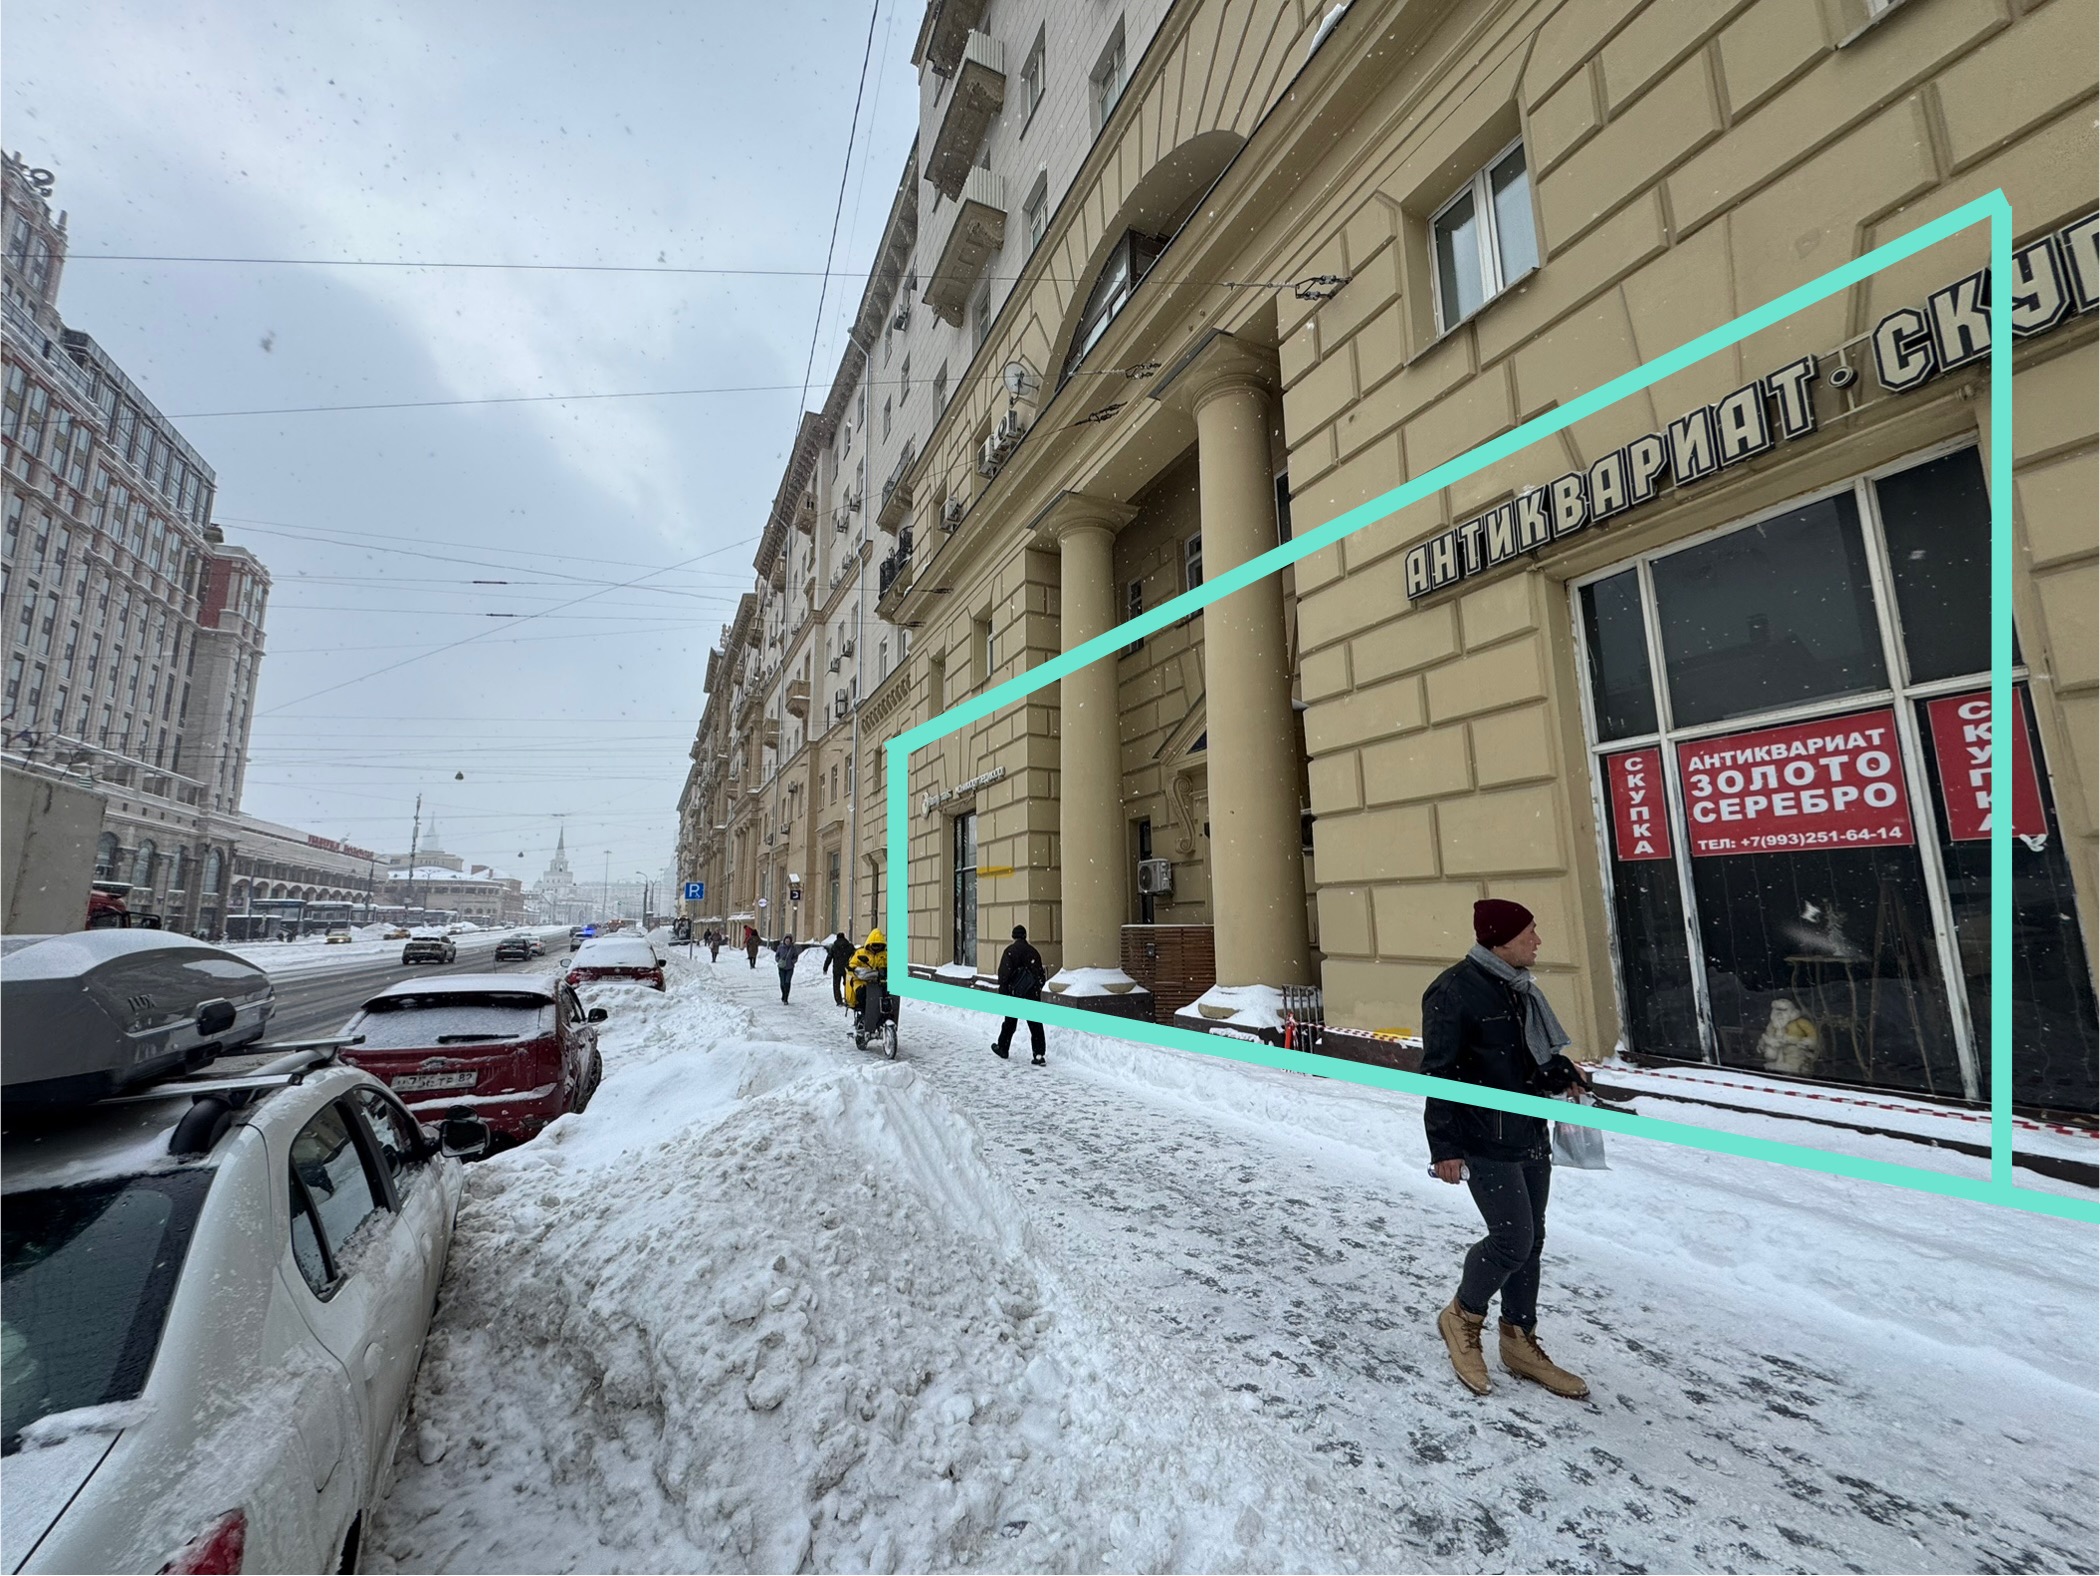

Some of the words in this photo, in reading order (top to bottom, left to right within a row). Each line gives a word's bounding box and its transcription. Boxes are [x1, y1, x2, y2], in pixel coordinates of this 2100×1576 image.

[1405, 354, 1819, 600] АНТИКВАРИАТ
[1688, 728, 1885, 771] АНТИКВАРИАТ
[1690, 751, 1891, 797] ЗОЛОТО
[1624, 757, 1655, 854] СКУПКА
[1693, 782, 1897, 823] СЕРЕБРО
[1698, 838, 1736, 850] ТЕЛ:
[1740, 826, 1902, 848] +7(993)251-64-14
